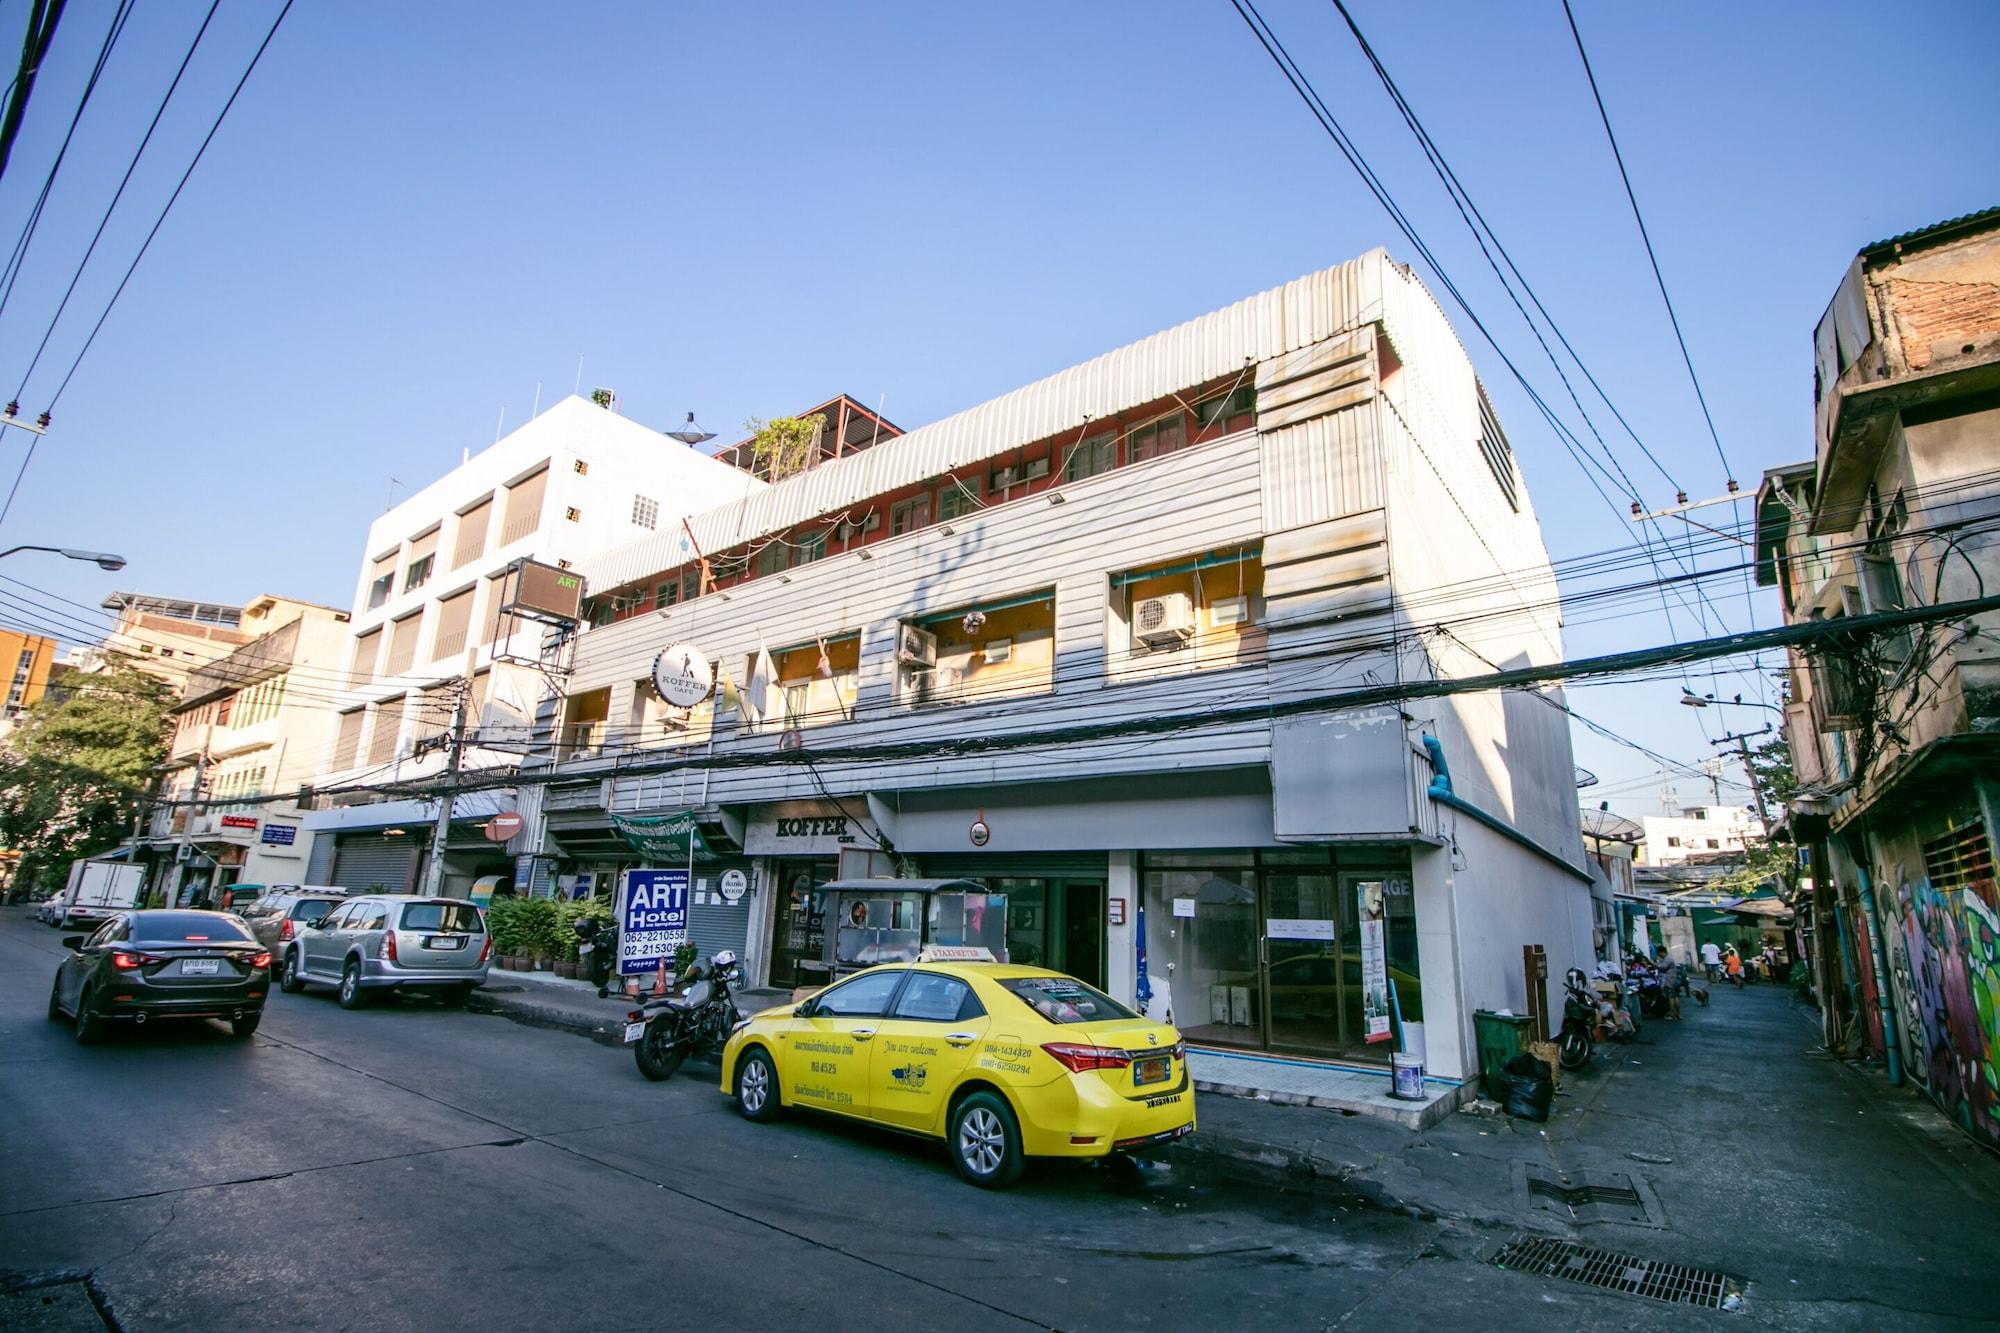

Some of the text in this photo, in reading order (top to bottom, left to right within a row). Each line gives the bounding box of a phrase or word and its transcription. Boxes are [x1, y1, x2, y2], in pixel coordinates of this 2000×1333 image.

[557, 576, 577, 589] ART
[663, 675, 707, 691] KOFFER
[776, 815, 848, 837] KOFFER
[629, 883, 687, 910] ART
[629, 909, 685, 929] Hotel
[625, 930, 685, 943] 062-2210558
[910, 1042, 938, 1056] welcome
